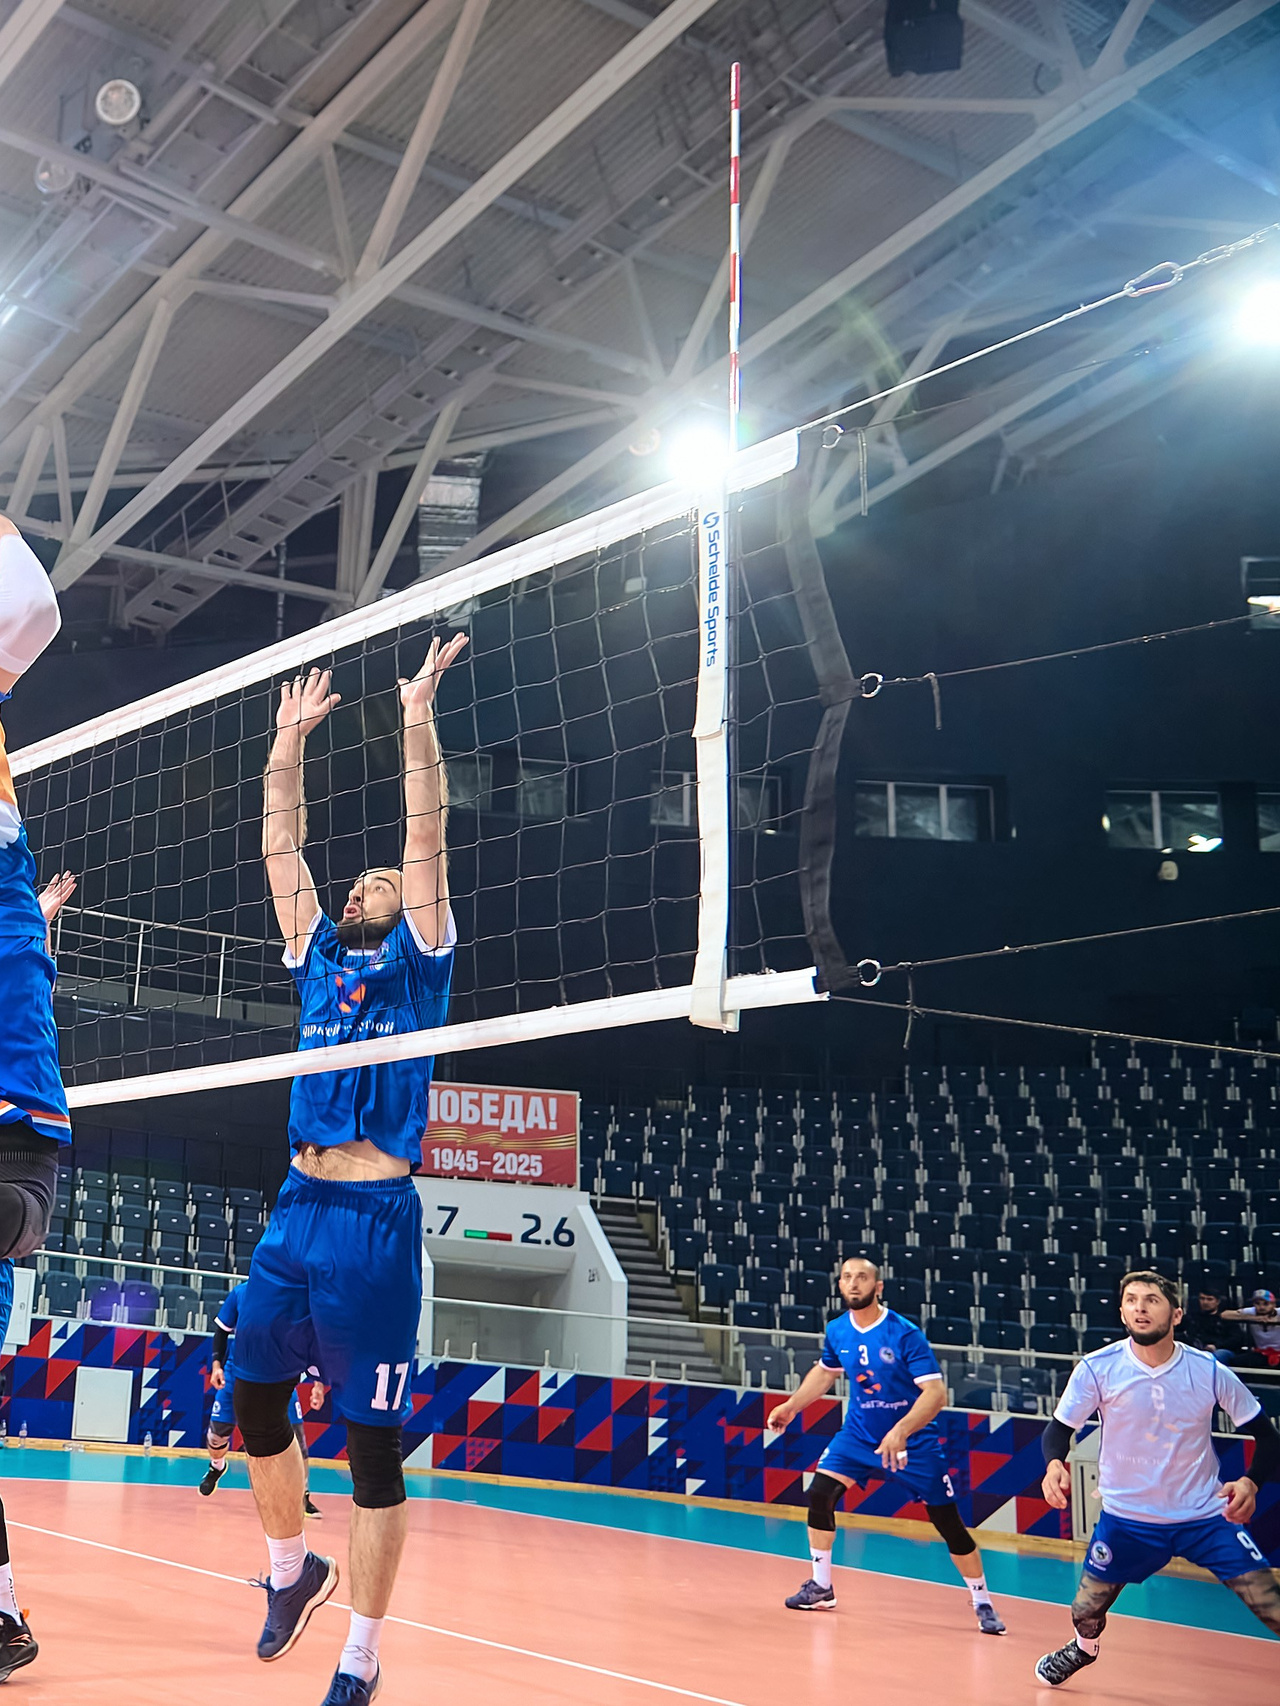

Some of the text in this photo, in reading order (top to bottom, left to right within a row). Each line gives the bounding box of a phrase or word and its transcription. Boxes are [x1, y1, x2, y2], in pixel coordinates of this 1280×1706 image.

[704, 530, 721, 667] Schelde Sports
[520, 1213, 576, 1248] 2.6
[858, 1344, 869, 1366] 3
[370, 1361, 410, 1411] 17
[942, 1473, 955, 1497] 3
[1236, 1530, 1264, 1562] 9
